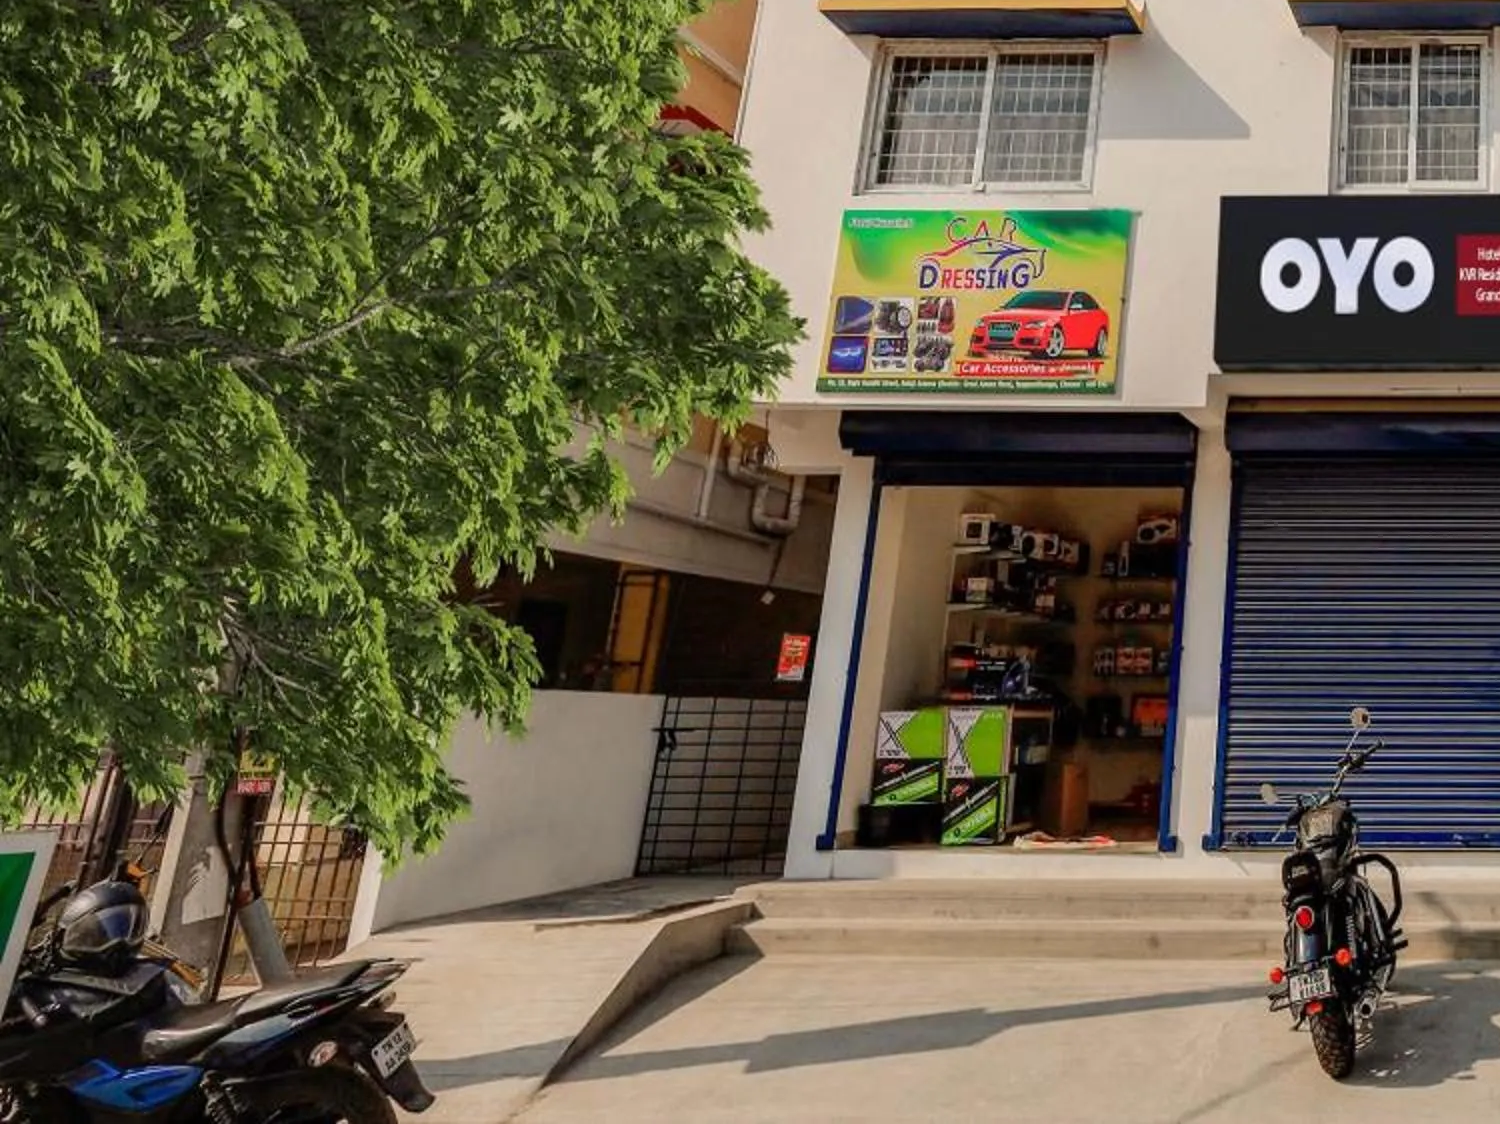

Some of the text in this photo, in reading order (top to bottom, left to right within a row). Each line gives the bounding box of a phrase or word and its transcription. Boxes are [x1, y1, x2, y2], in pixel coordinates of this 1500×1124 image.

[947, 217, 1017, 244] CAR
[918, 262, 1030, 289] DRESSING
[1260, 236, 1435, 314] OYO
[1459, 267, 1477, 281] KVR
[961, 363, 981, 374] Car
[984, 363, 1045, 375] Accessories
